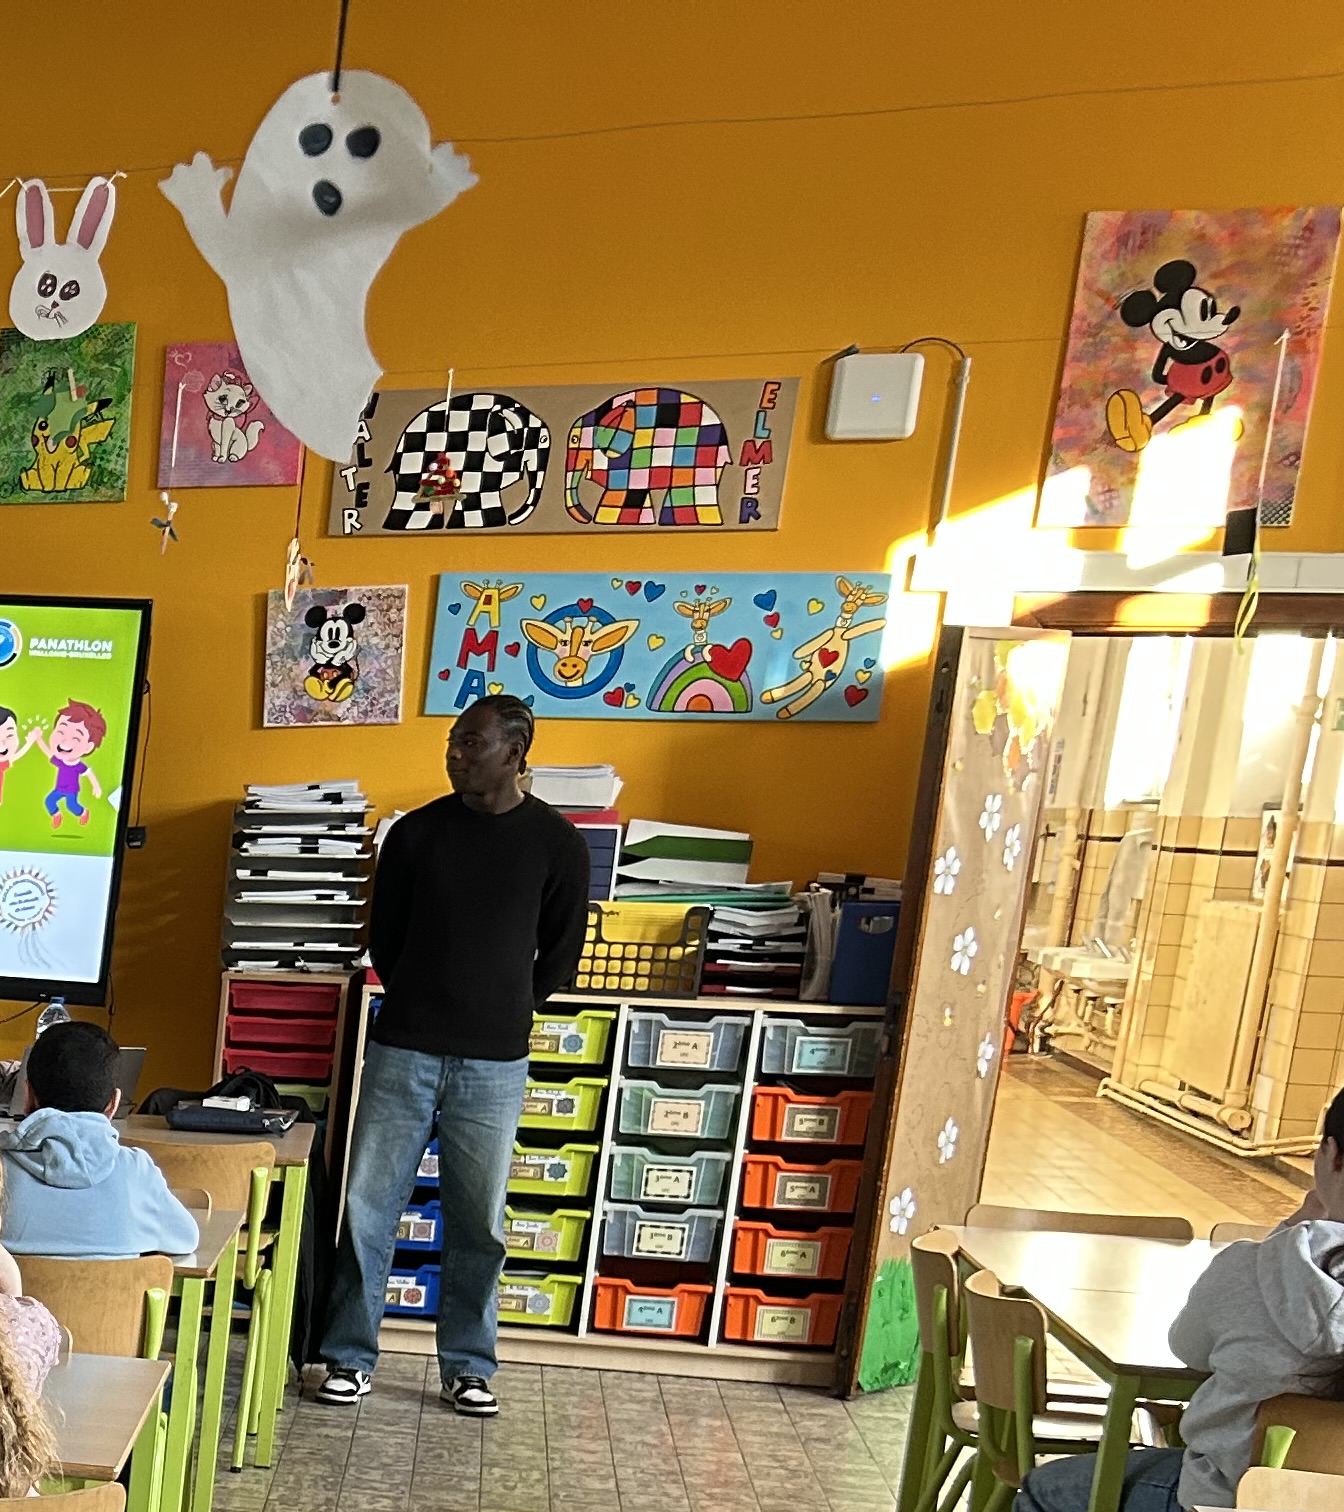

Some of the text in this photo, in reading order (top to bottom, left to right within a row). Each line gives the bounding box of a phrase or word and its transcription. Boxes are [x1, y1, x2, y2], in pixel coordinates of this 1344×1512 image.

[739, 381, 781, 524] ELMER
[30, 638, 113, 652] PANATHLON
[800, 1251, 806, 1259] A
